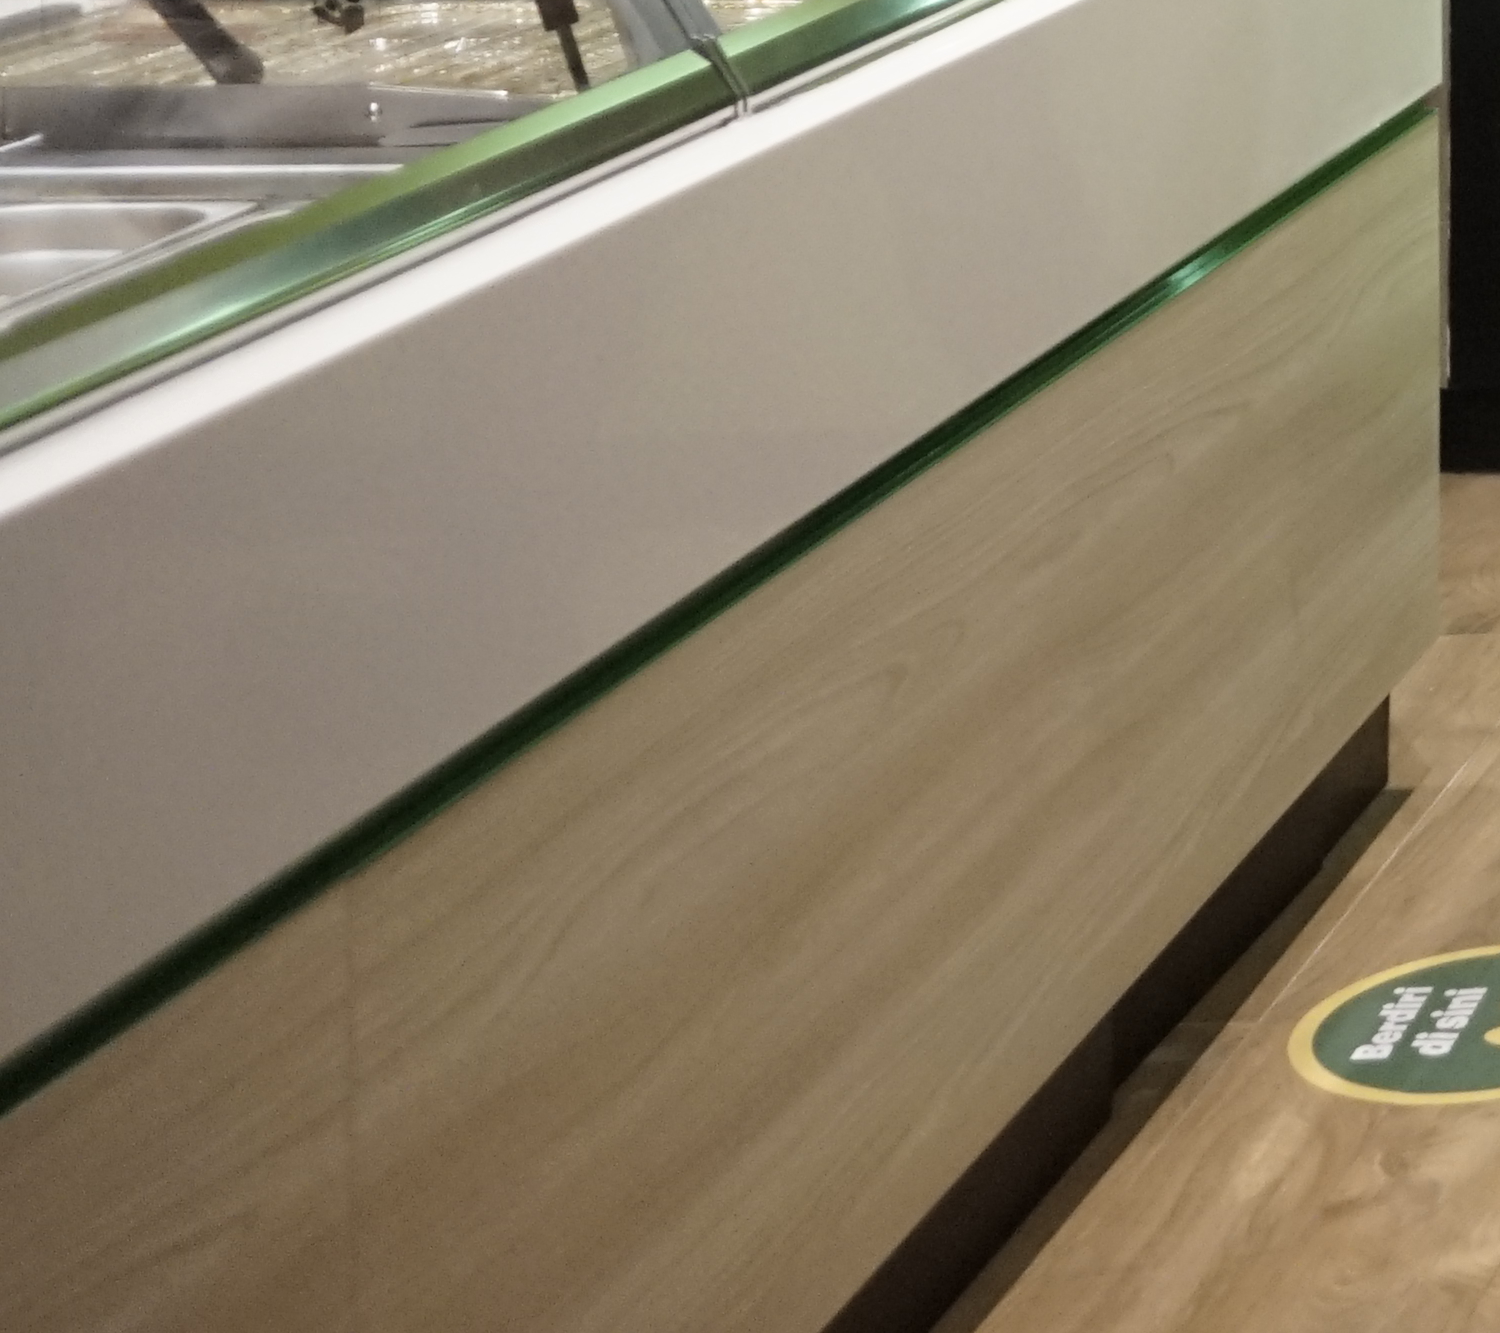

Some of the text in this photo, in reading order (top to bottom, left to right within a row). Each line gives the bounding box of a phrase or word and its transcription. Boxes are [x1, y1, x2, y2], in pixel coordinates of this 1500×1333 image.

[1349, 986, 1435, 1061] Berdiri
[1411, 986, 1488, 1056] di sini
